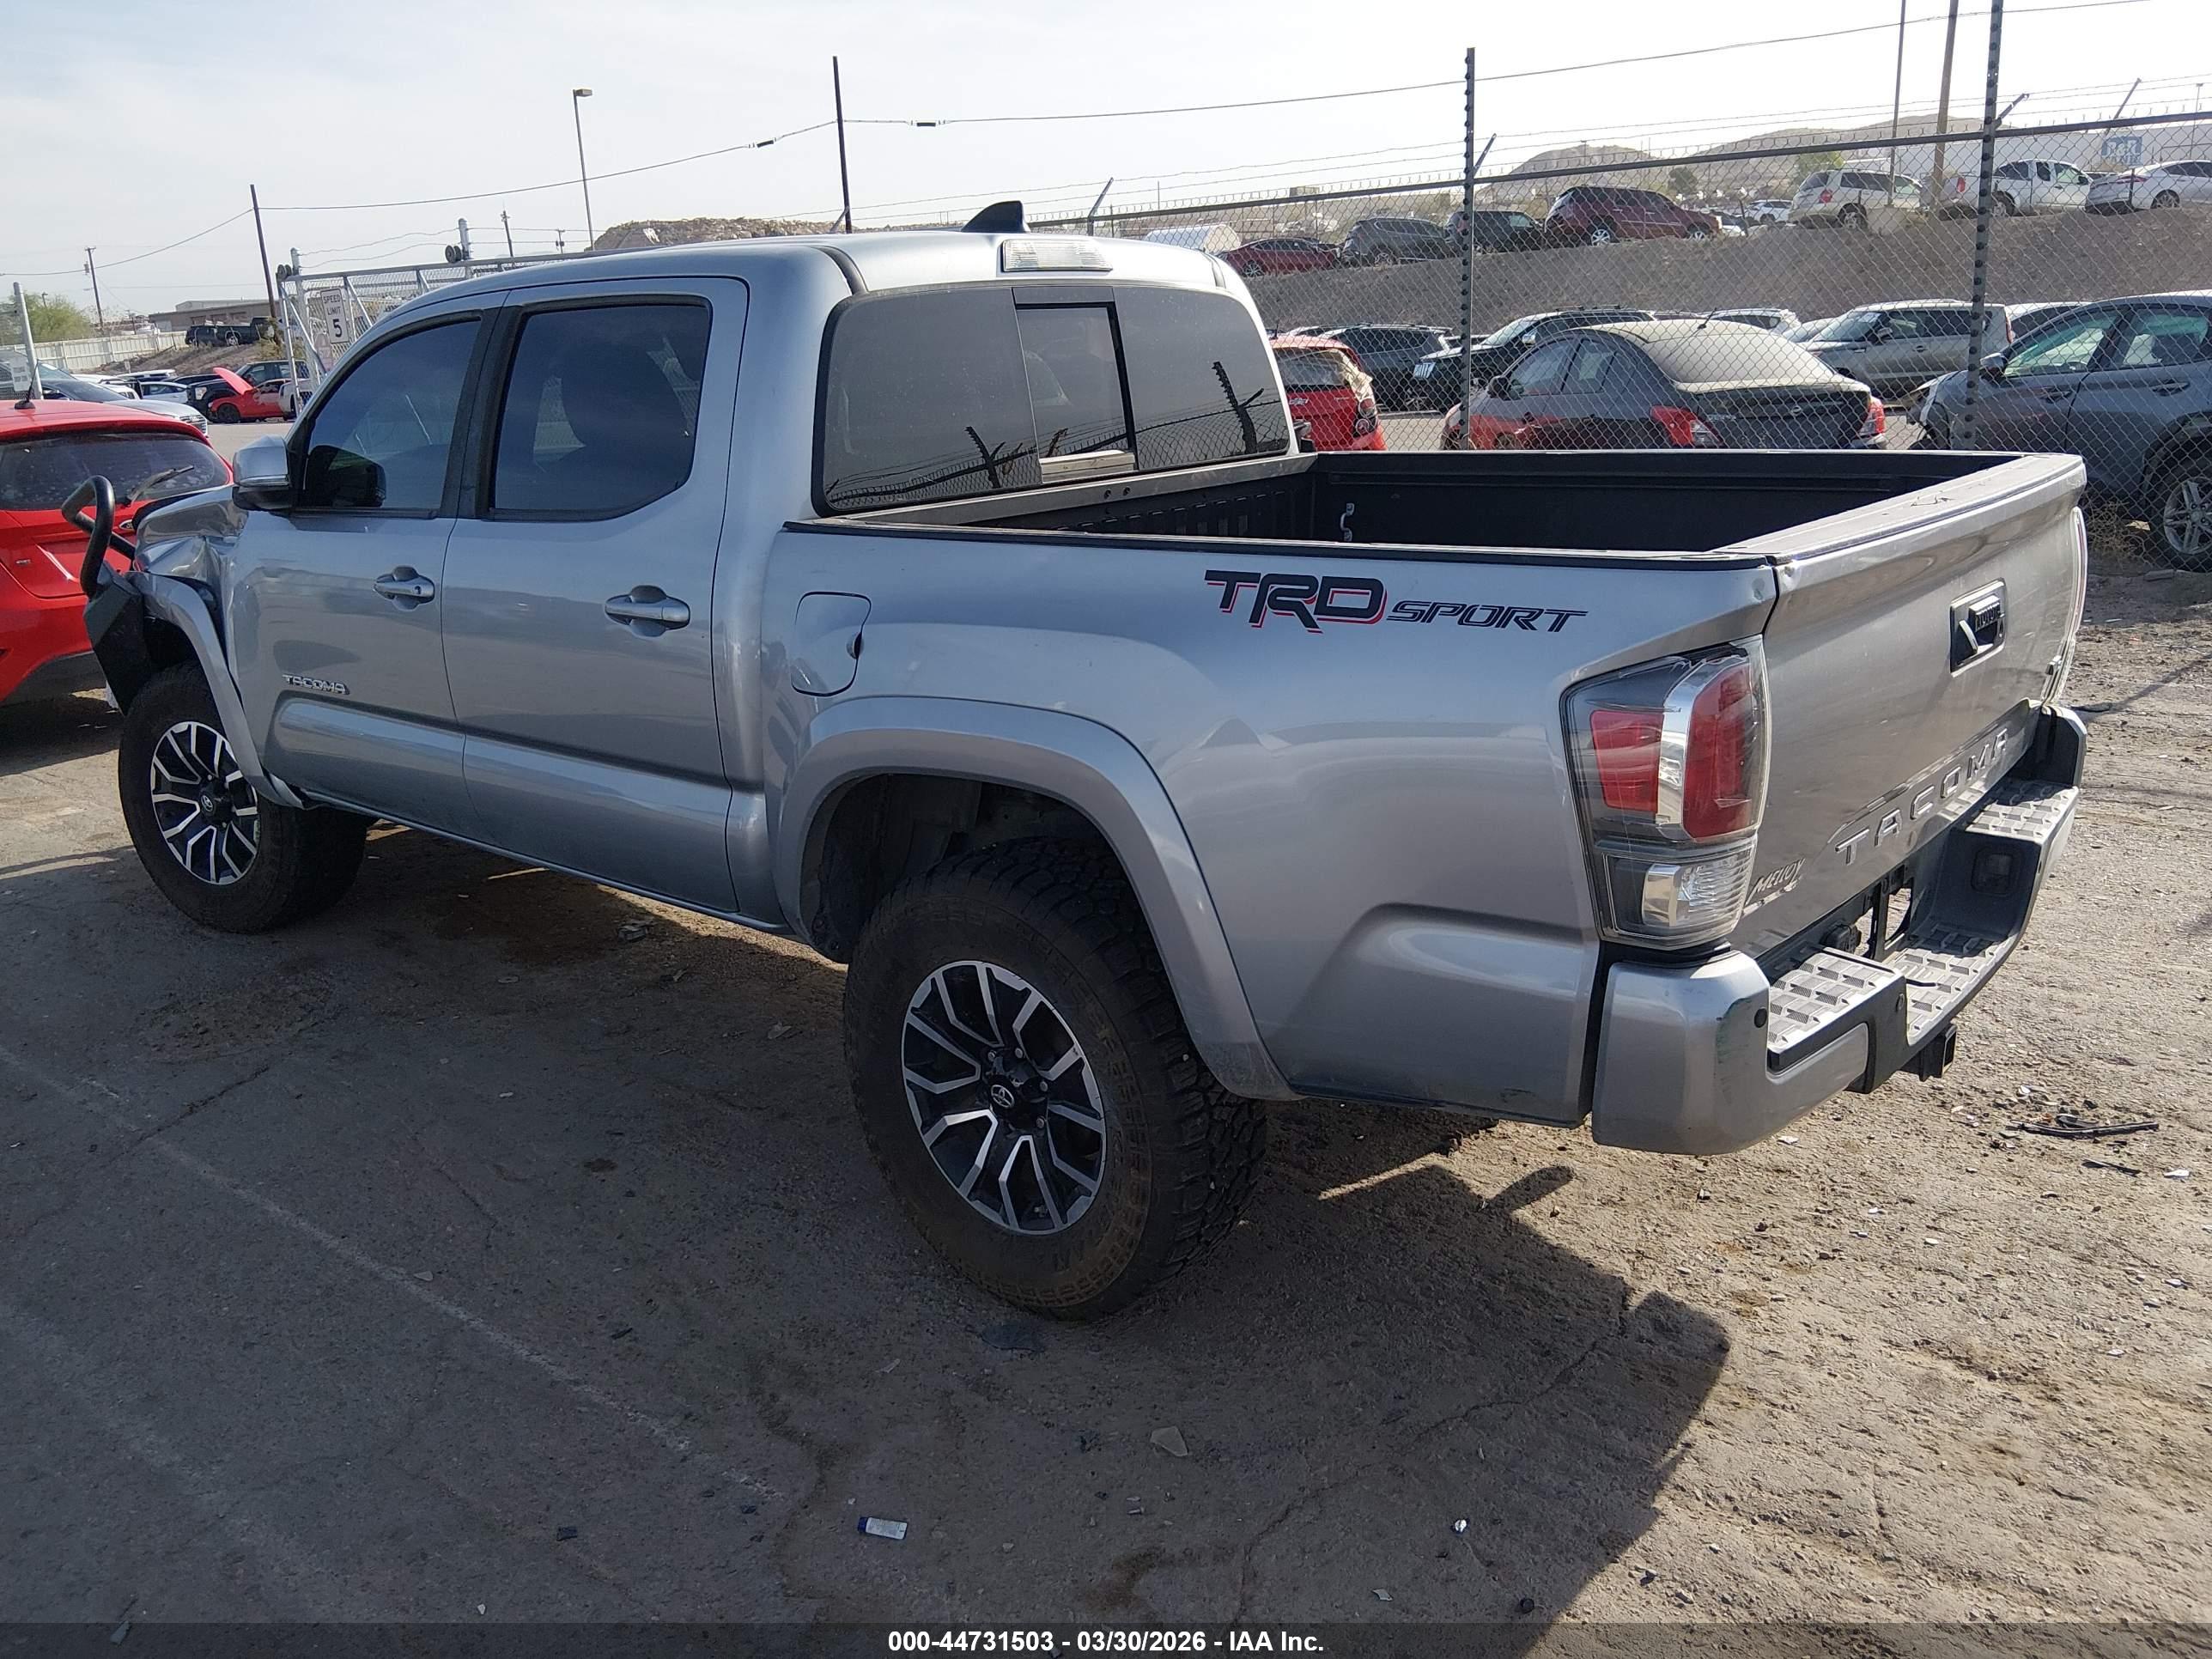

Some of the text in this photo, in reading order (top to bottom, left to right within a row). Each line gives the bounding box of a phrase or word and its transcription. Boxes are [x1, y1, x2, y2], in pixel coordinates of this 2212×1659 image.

[323, 295, 341, 304] SPEED
[327, 306, 341, 316] LIMIT
[332, 319, 343, 337] 5
[1204, 569, 1588, 634] TRD SPORT
[282, 674, 349, 695] TACOMA
[1834, 728, 2008, 866] TACOMA
